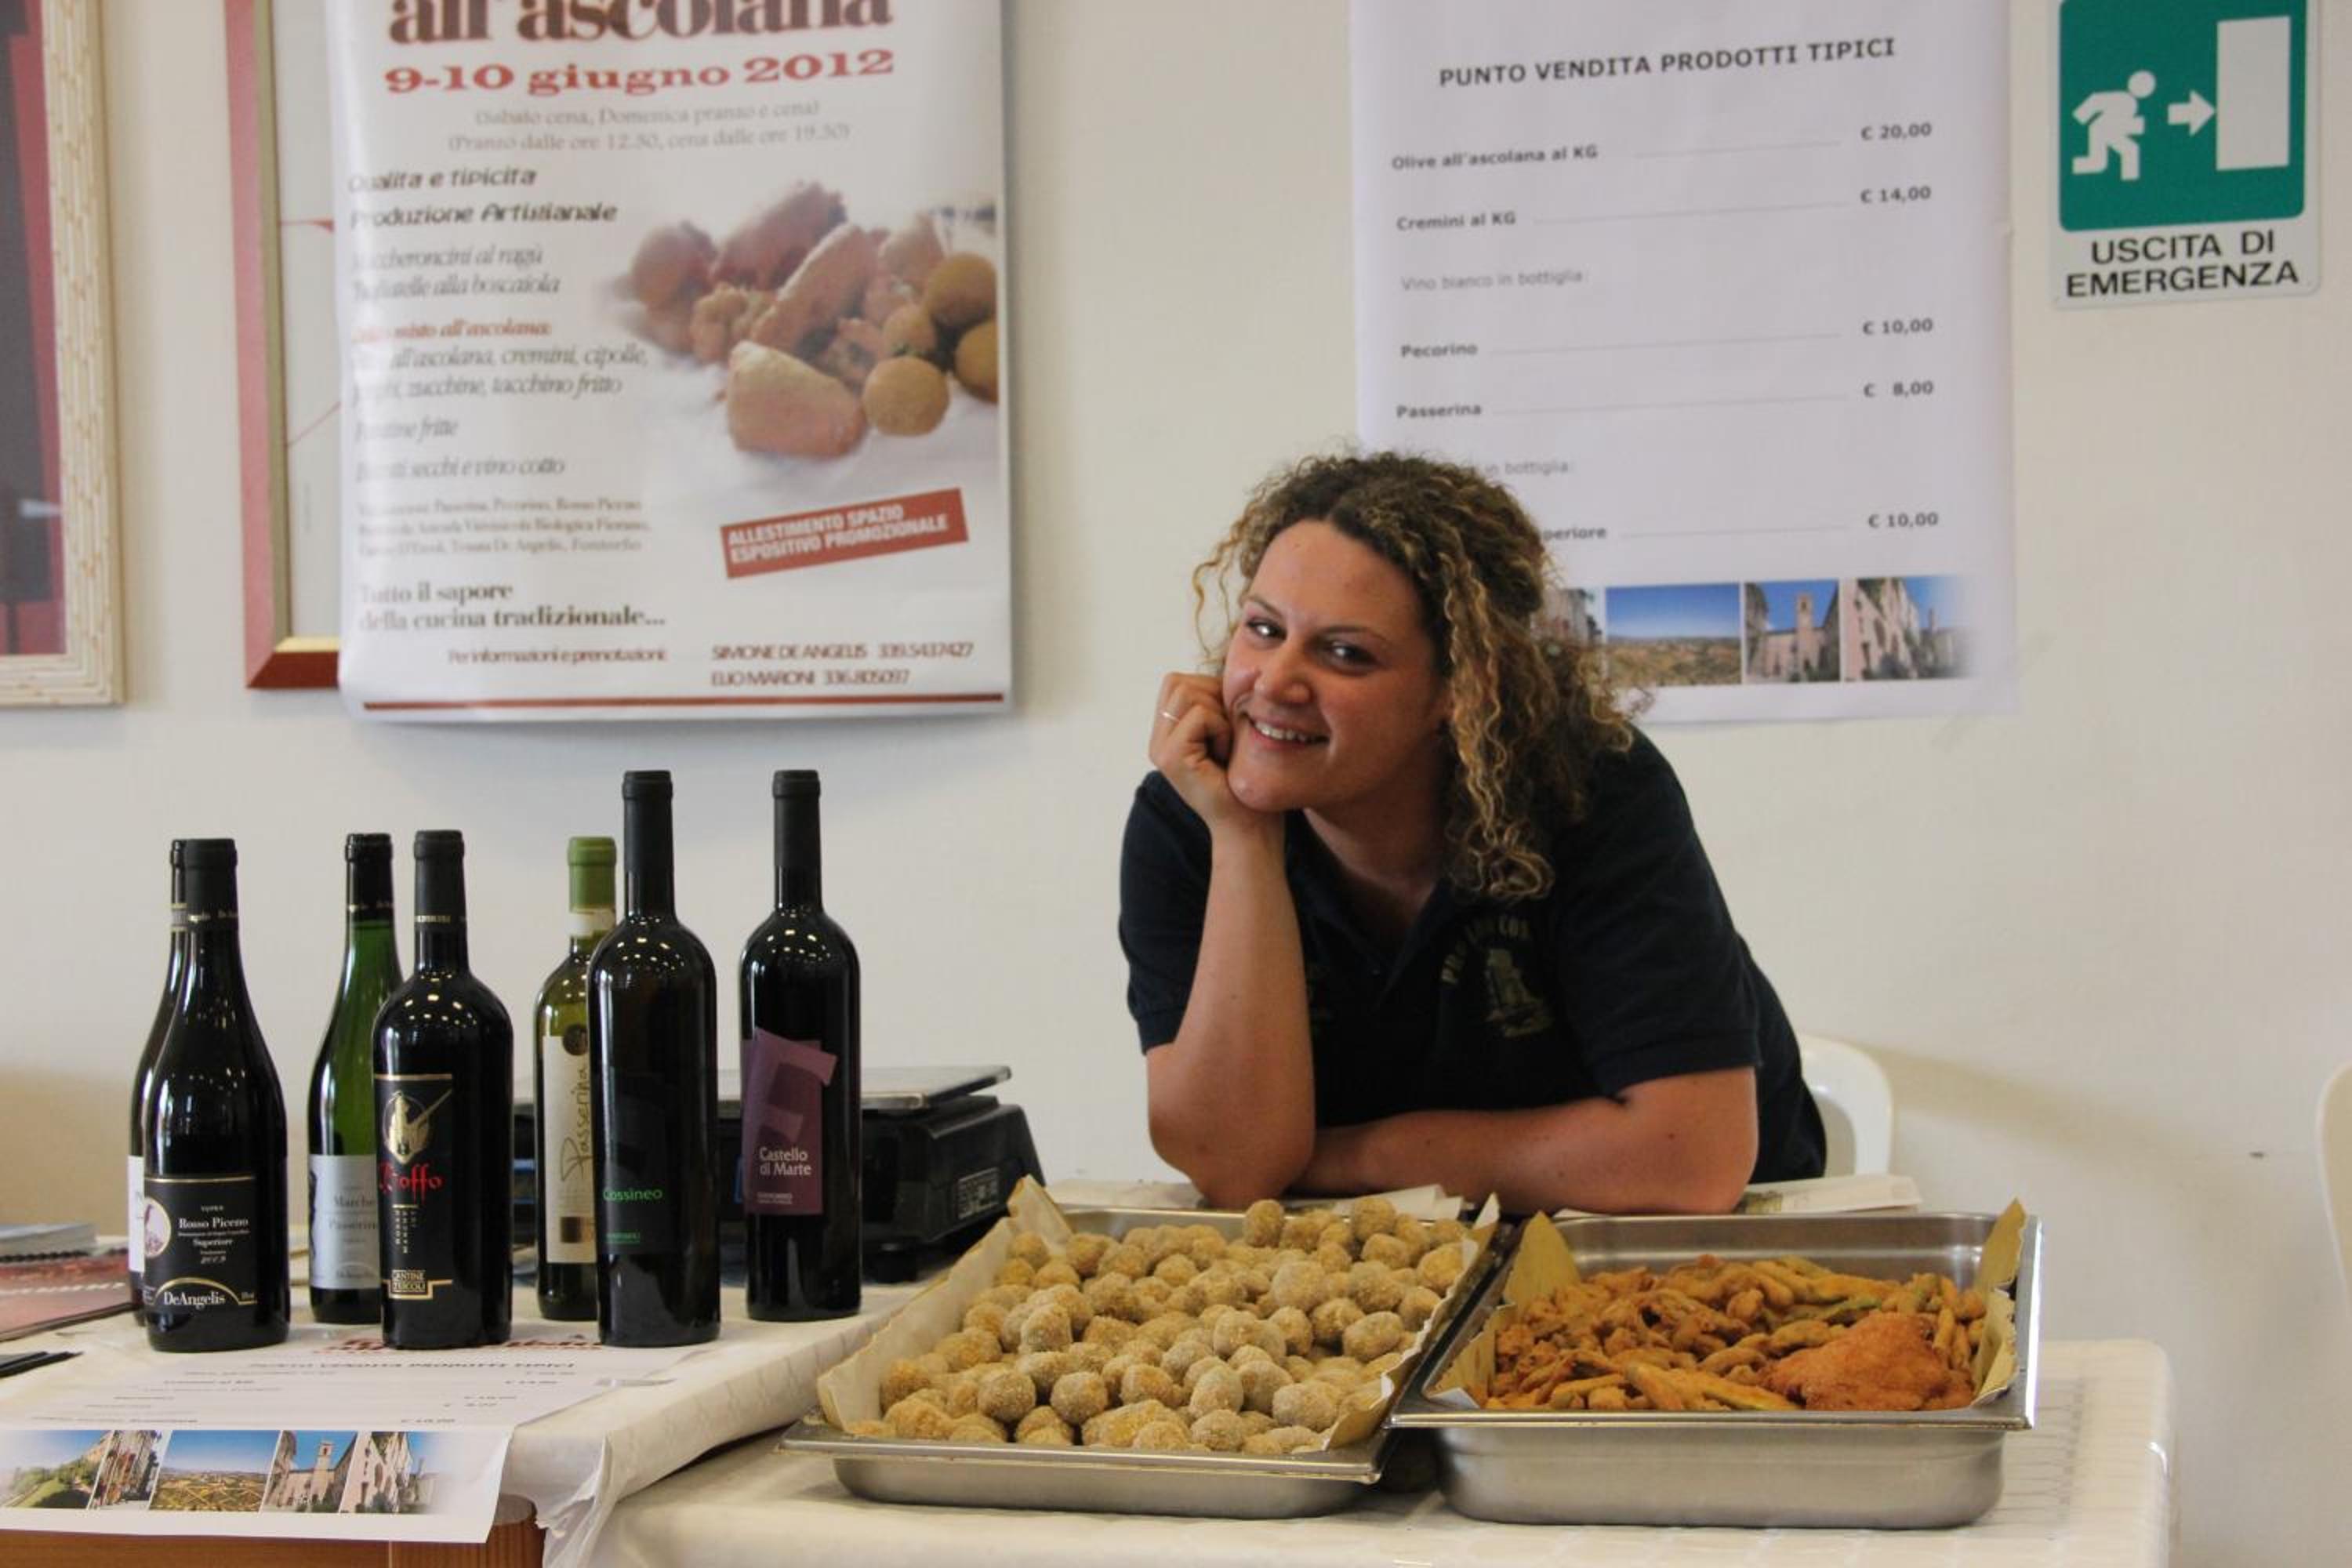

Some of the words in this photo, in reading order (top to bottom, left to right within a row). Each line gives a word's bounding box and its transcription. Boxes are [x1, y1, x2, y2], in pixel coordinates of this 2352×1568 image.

[1439, 64, 1526, 86] PUNTO
[1535, 56, 1651, 81] VENDITA
[1661, 45, 1797, 72] PRODOTTI
[1806, 38, 1895, 62] TIPICI
[384, 63, 514, 94] 9-10
[527, 64, 731, 97] giugno
[742, 49, 895, 83] 2012
[569, 138, 600, 150] ore
[760, 129, 789, 143] ore
[1879, 122, 1932, 141] 20,00
[1392, 154, 1436, 170] Olive
[1443, 149, 1545, 167] all'ascolana
[1552, 146, 1567, 161] al
[1573, 143, 1598, 159] KG
[429, 172, 443, 188] e
[1879, 186, 1931, 204] 14,00
[1396, 215, 1465, 231] Cremini
[1471, 213, 1486, 227] al
[1491, 211, 1516, 226] KG
[2091, 234, 2222, 265] USCITA
[2241, 229, 2274, 256] DI
[1401, 276, 1436, 291] Vino
[1443, 274, 1494, 289] bianco
[1498, 273, 1512, 286] in
[2066, 260, 2299, 298] EMERGENZA
[1882, 318, 1933, 336] 10,00
[1401, 342, 1478, 358] Pecorino
[1893, 381, 1934, 398] 8,00
[1396, 403, 1482, 419] Passerina
[728, 514, 844, 547] ALLESTIMENTO
[847, 503, 904, 527] SPAZIO
[1887, 512, 1939, 529] 10,00
[730, 536, 822, 564] ESPOSITIVO
[825, 514, 948, 550] PROMOZIONALE
[417, 580, 430, 601] il
[436, 584, 513, 607] sapore
[413, 608, 486, 630] cucina
[493, 605, 666, 627] tradizionale...
[759, 1147, 808, 1161] Castello
[760, 1161, 771, 1175] di
[774, 1161, 812, 1176] Marte
[178, 1218, 209, 1230] Rosso
[212, 1218, 249, 1229] Piceno
